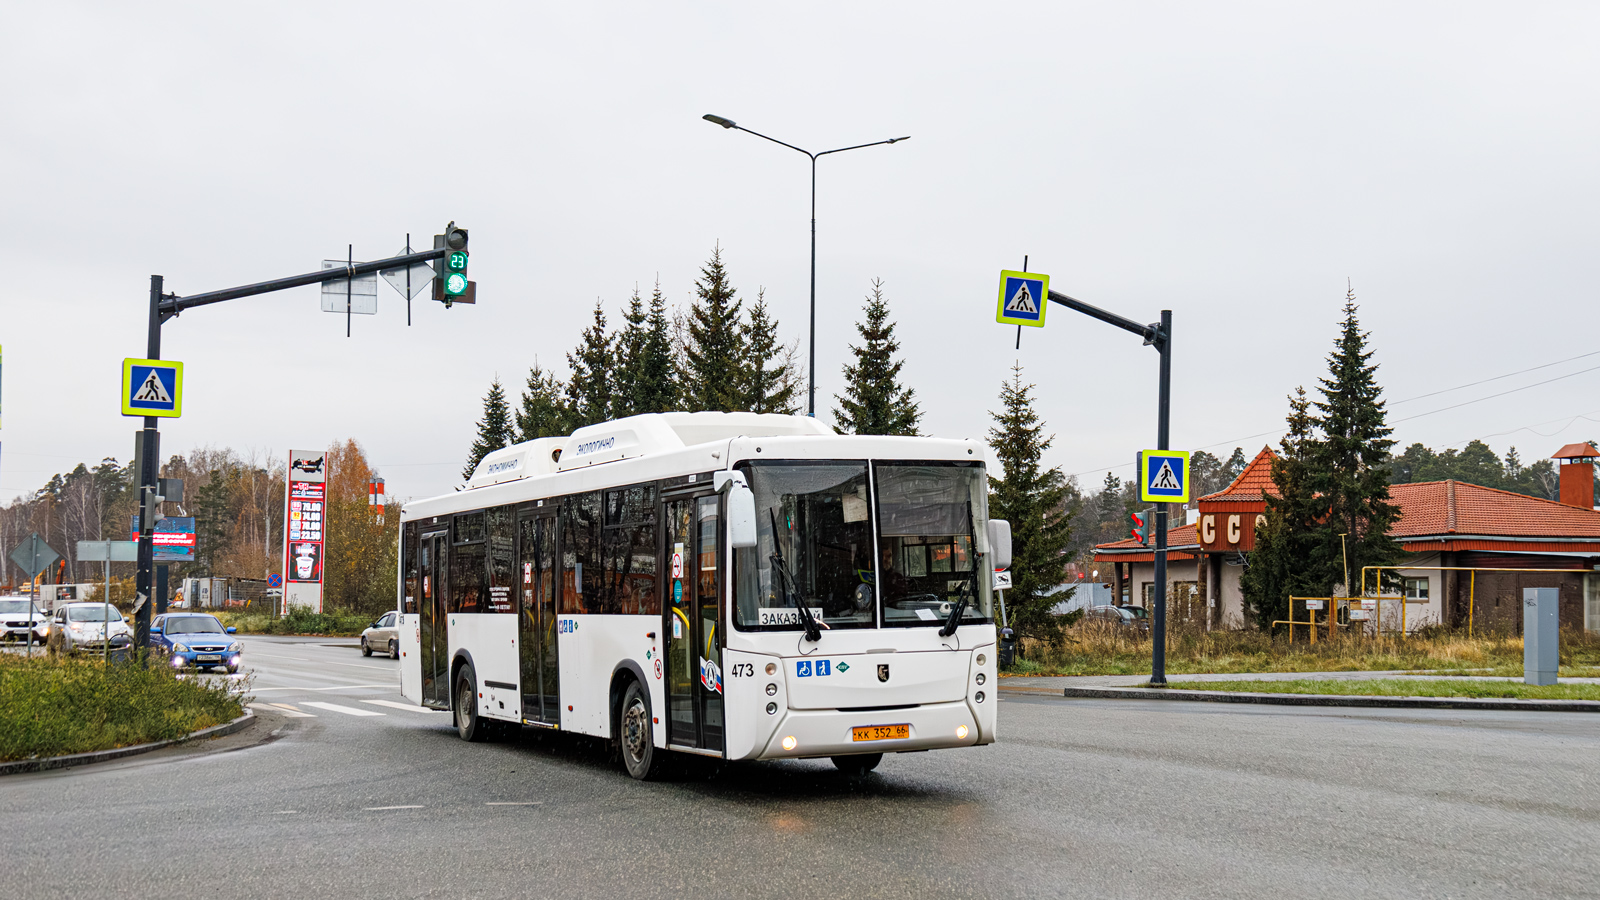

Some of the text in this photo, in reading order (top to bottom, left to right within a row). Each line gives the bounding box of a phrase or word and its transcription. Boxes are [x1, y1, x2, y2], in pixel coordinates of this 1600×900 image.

[451, 255, 464, 268] 23
[576, 437, 615, 455] ЭКОЛОГИЧНО
[487, 459, 518, 474] ЭКОНОМИЧНО
[761, 610, 821, 625] ЗАКАЗНЙ
[731, 663, 754, 678] 473
[857, 731, 869, 739] КК
[874, 727, 891, 739] 352
[896, 726, 906, 734] 66
